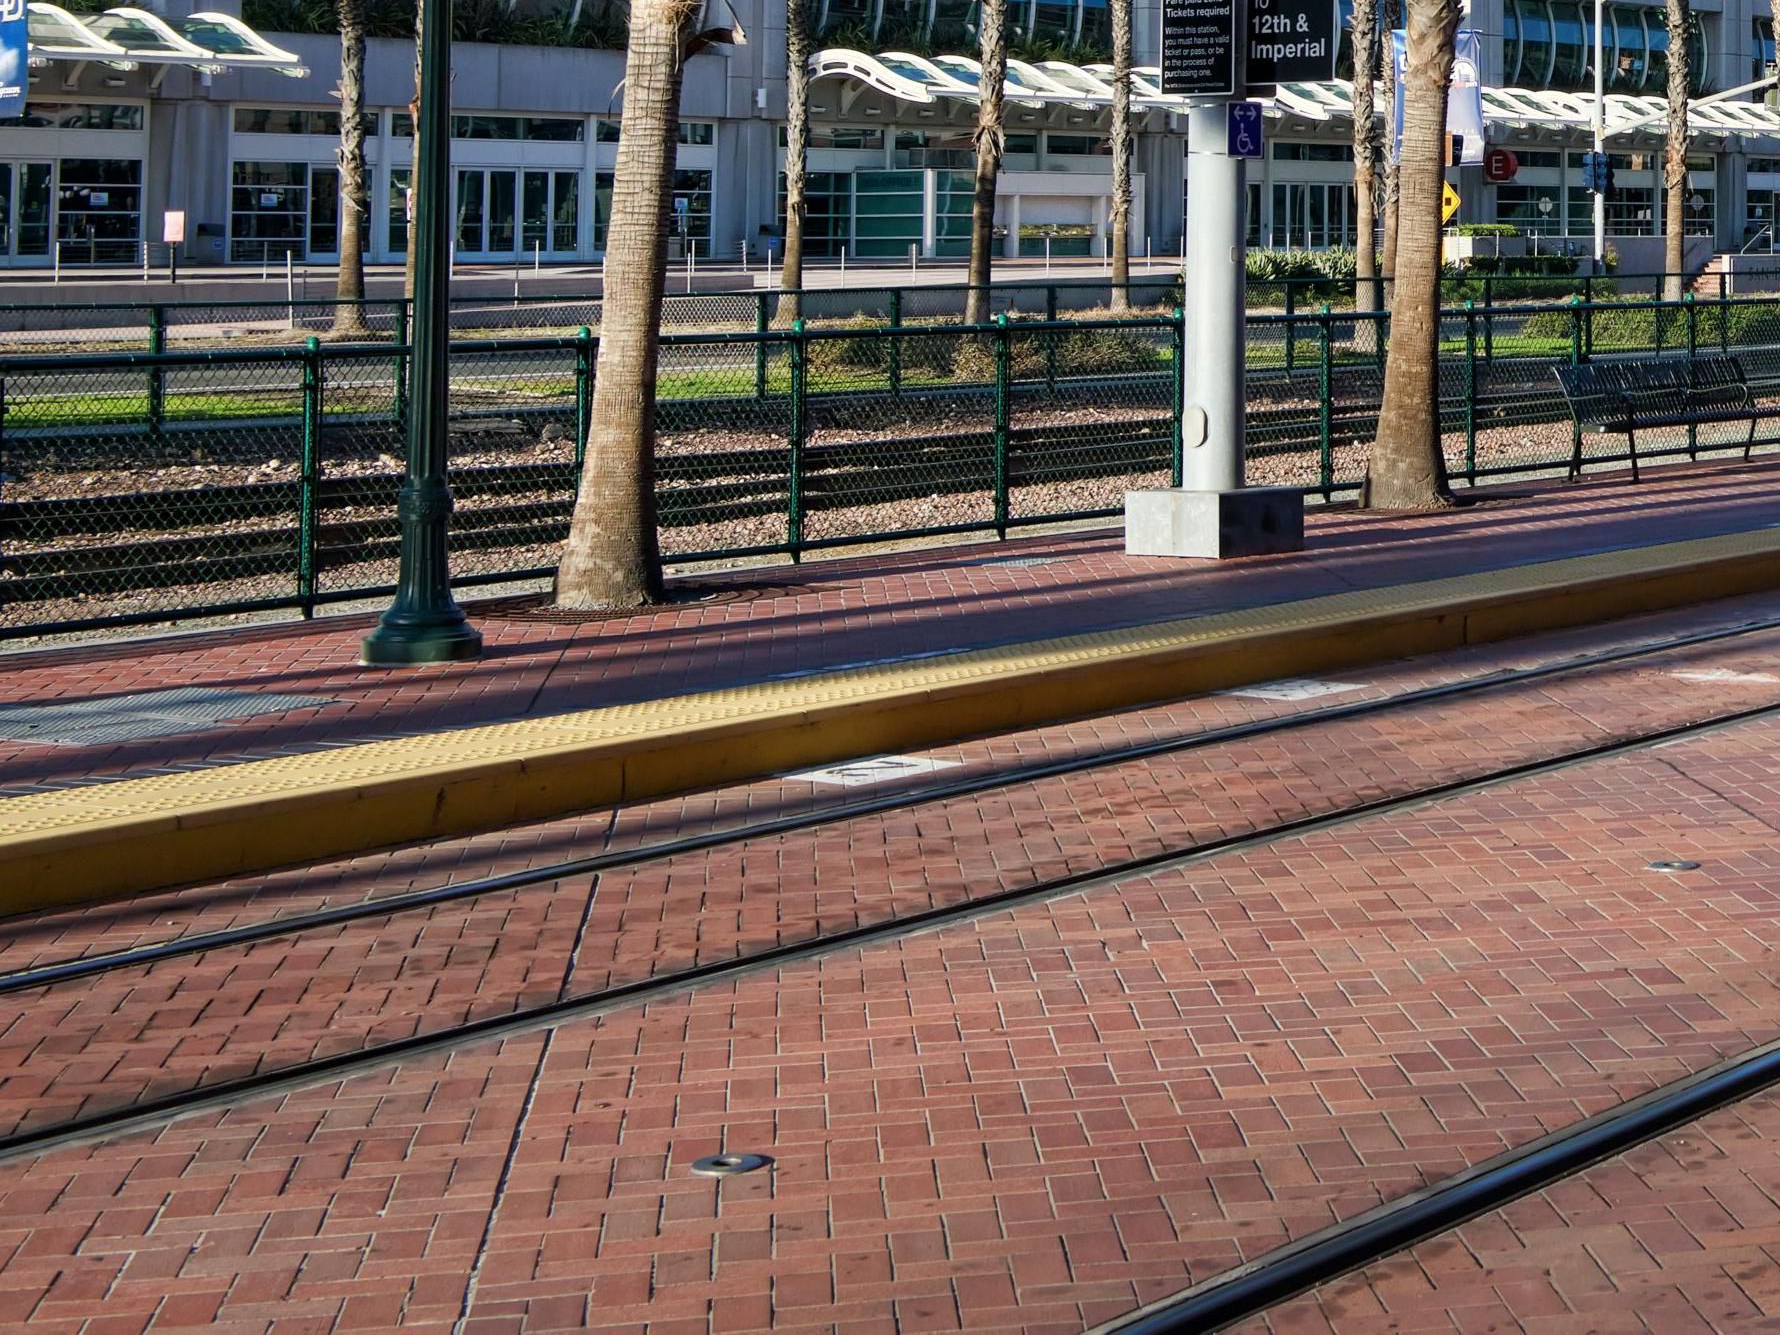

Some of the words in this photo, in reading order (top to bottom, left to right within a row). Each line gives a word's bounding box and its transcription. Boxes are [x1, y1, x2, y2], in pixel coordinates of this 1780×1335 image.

[1166, 8, 1195, 18] Tickets
[1196, 5, 1230, 17] required
[1252, 14, 1290, 34] 12th
[1296, 13, 1309, 32] &
[1165, 26, 1184, 35] Within
[1185, 26, 1196, 34] this
[1165, 39, 1176, 47] you
[1177, 37, 1193, 45] must
[1194, 36, 1209, 44] have
[1215, 34, 1230, 43] valid
[1165, 48, 1181, 56] ticket
[1216, 46, 1225, 54] be
[1252, 38, 1325, 62] Imperial
[1165, 59, 1170, 67] in
[1171, 59, 1181, 67] the
[1183, 58, 1207, 67] process
[1208, 56, 1215, 65] of
[1165, 68, 1198, 79] purchasing
[1492, 156, 1504, 174] E
